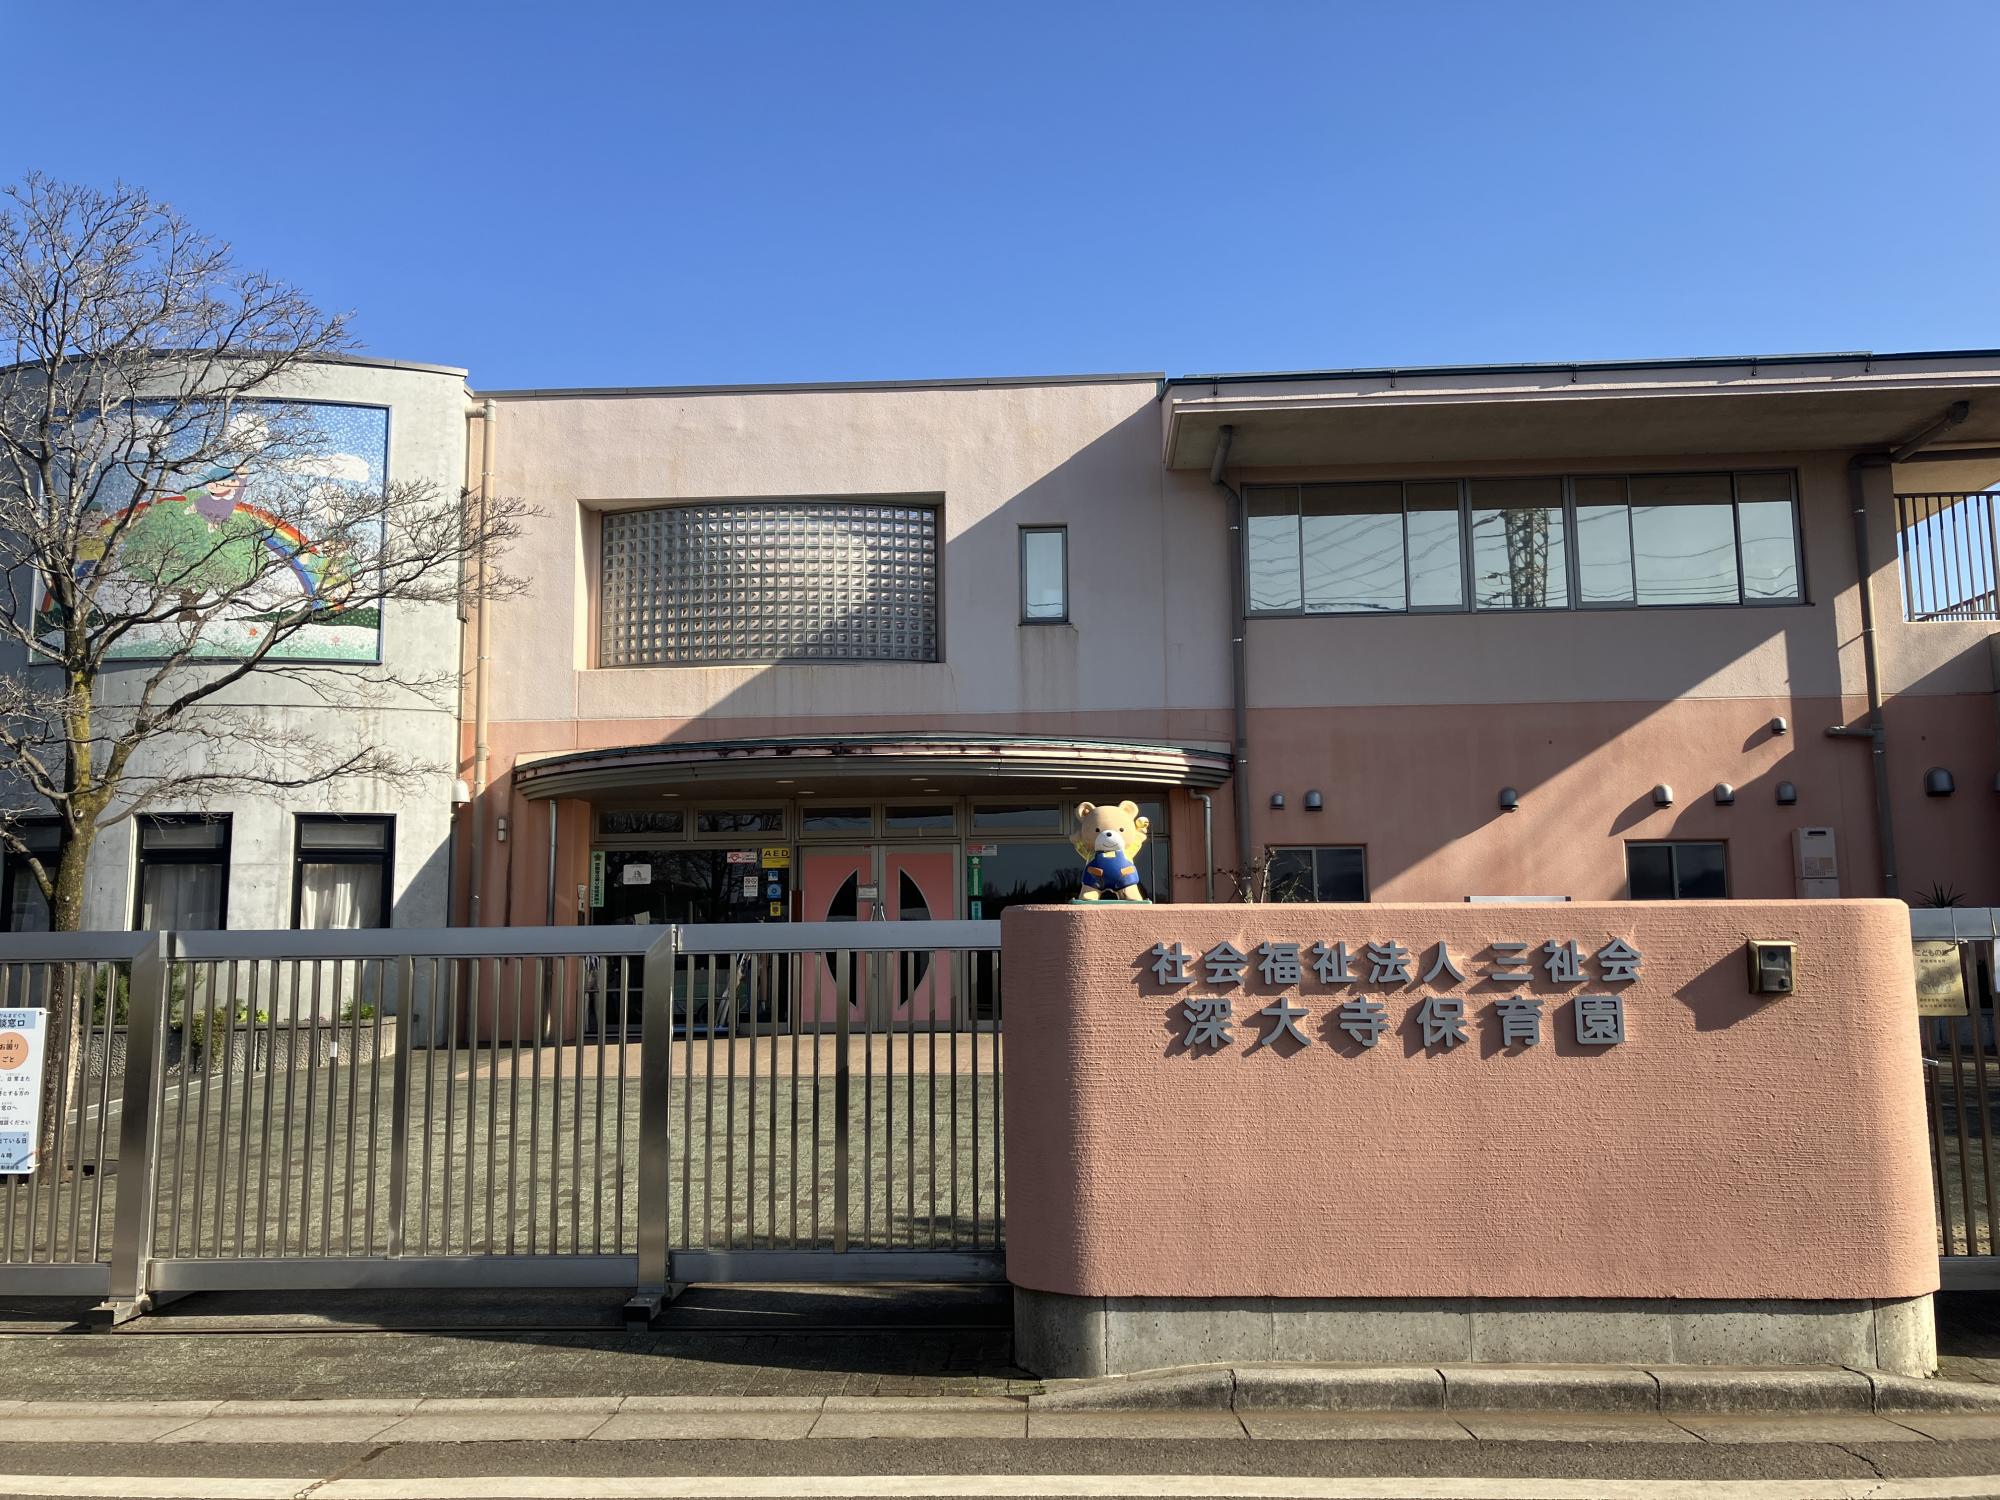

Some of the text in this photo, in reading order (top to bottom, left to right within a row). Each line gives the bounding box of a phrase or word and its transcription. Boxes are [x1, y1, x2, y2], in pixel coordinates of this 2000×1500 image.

[764, 849, 789, 857] AED
[1151, 938, 1643, 985] 社会福祉法人三祉会
[1184, 995, 1624, 1048] 深大寺保育園
